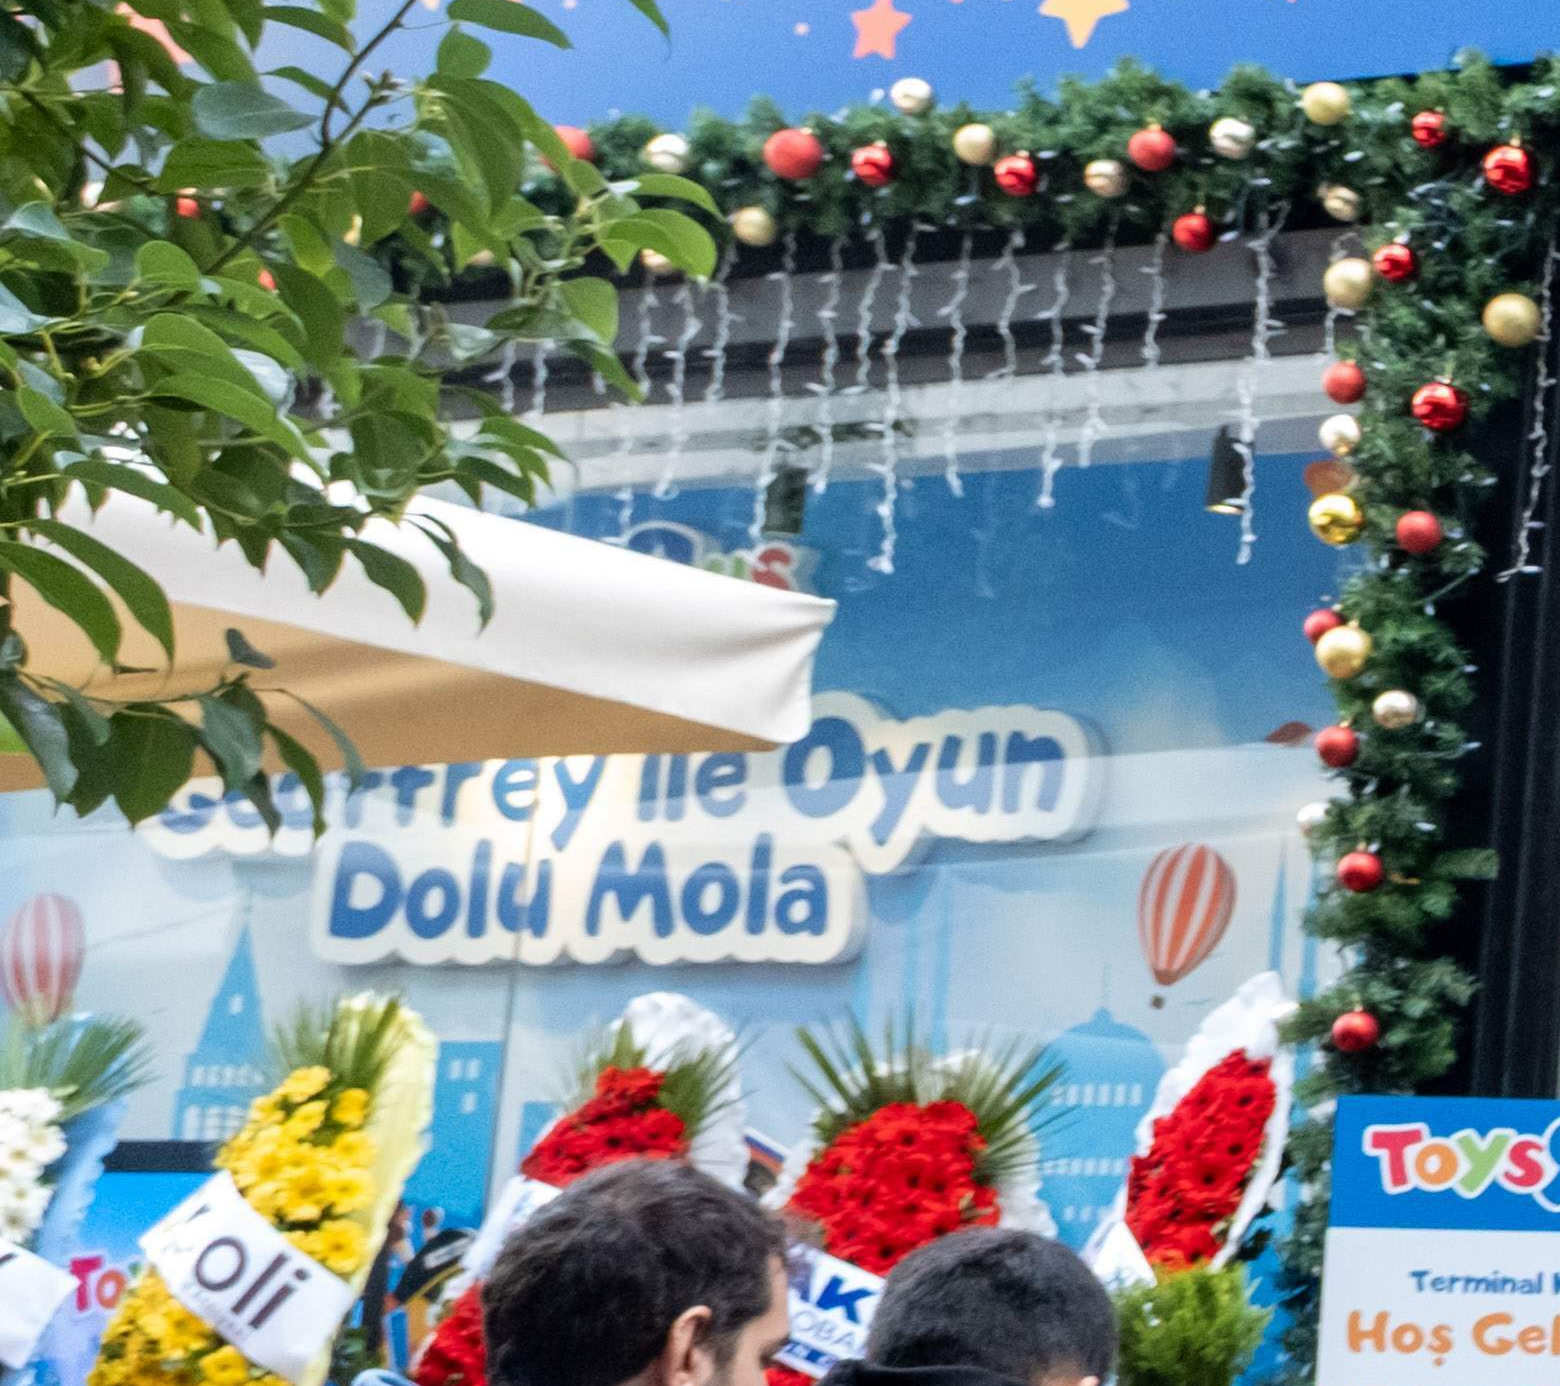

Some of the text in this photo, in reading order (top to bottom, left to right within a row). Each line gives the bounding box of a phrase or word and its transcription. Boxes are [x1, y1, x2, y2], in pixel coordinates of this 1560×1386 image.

[781, 716, 1070, 847] Oyun
[326, 833, 830, 940] Dolu Mola
[189, 1207, 311, 1330] oli
[1410, 1268, 1543, 1297] Terminal
[1346, 1309, 1454, 1367] Hoş
